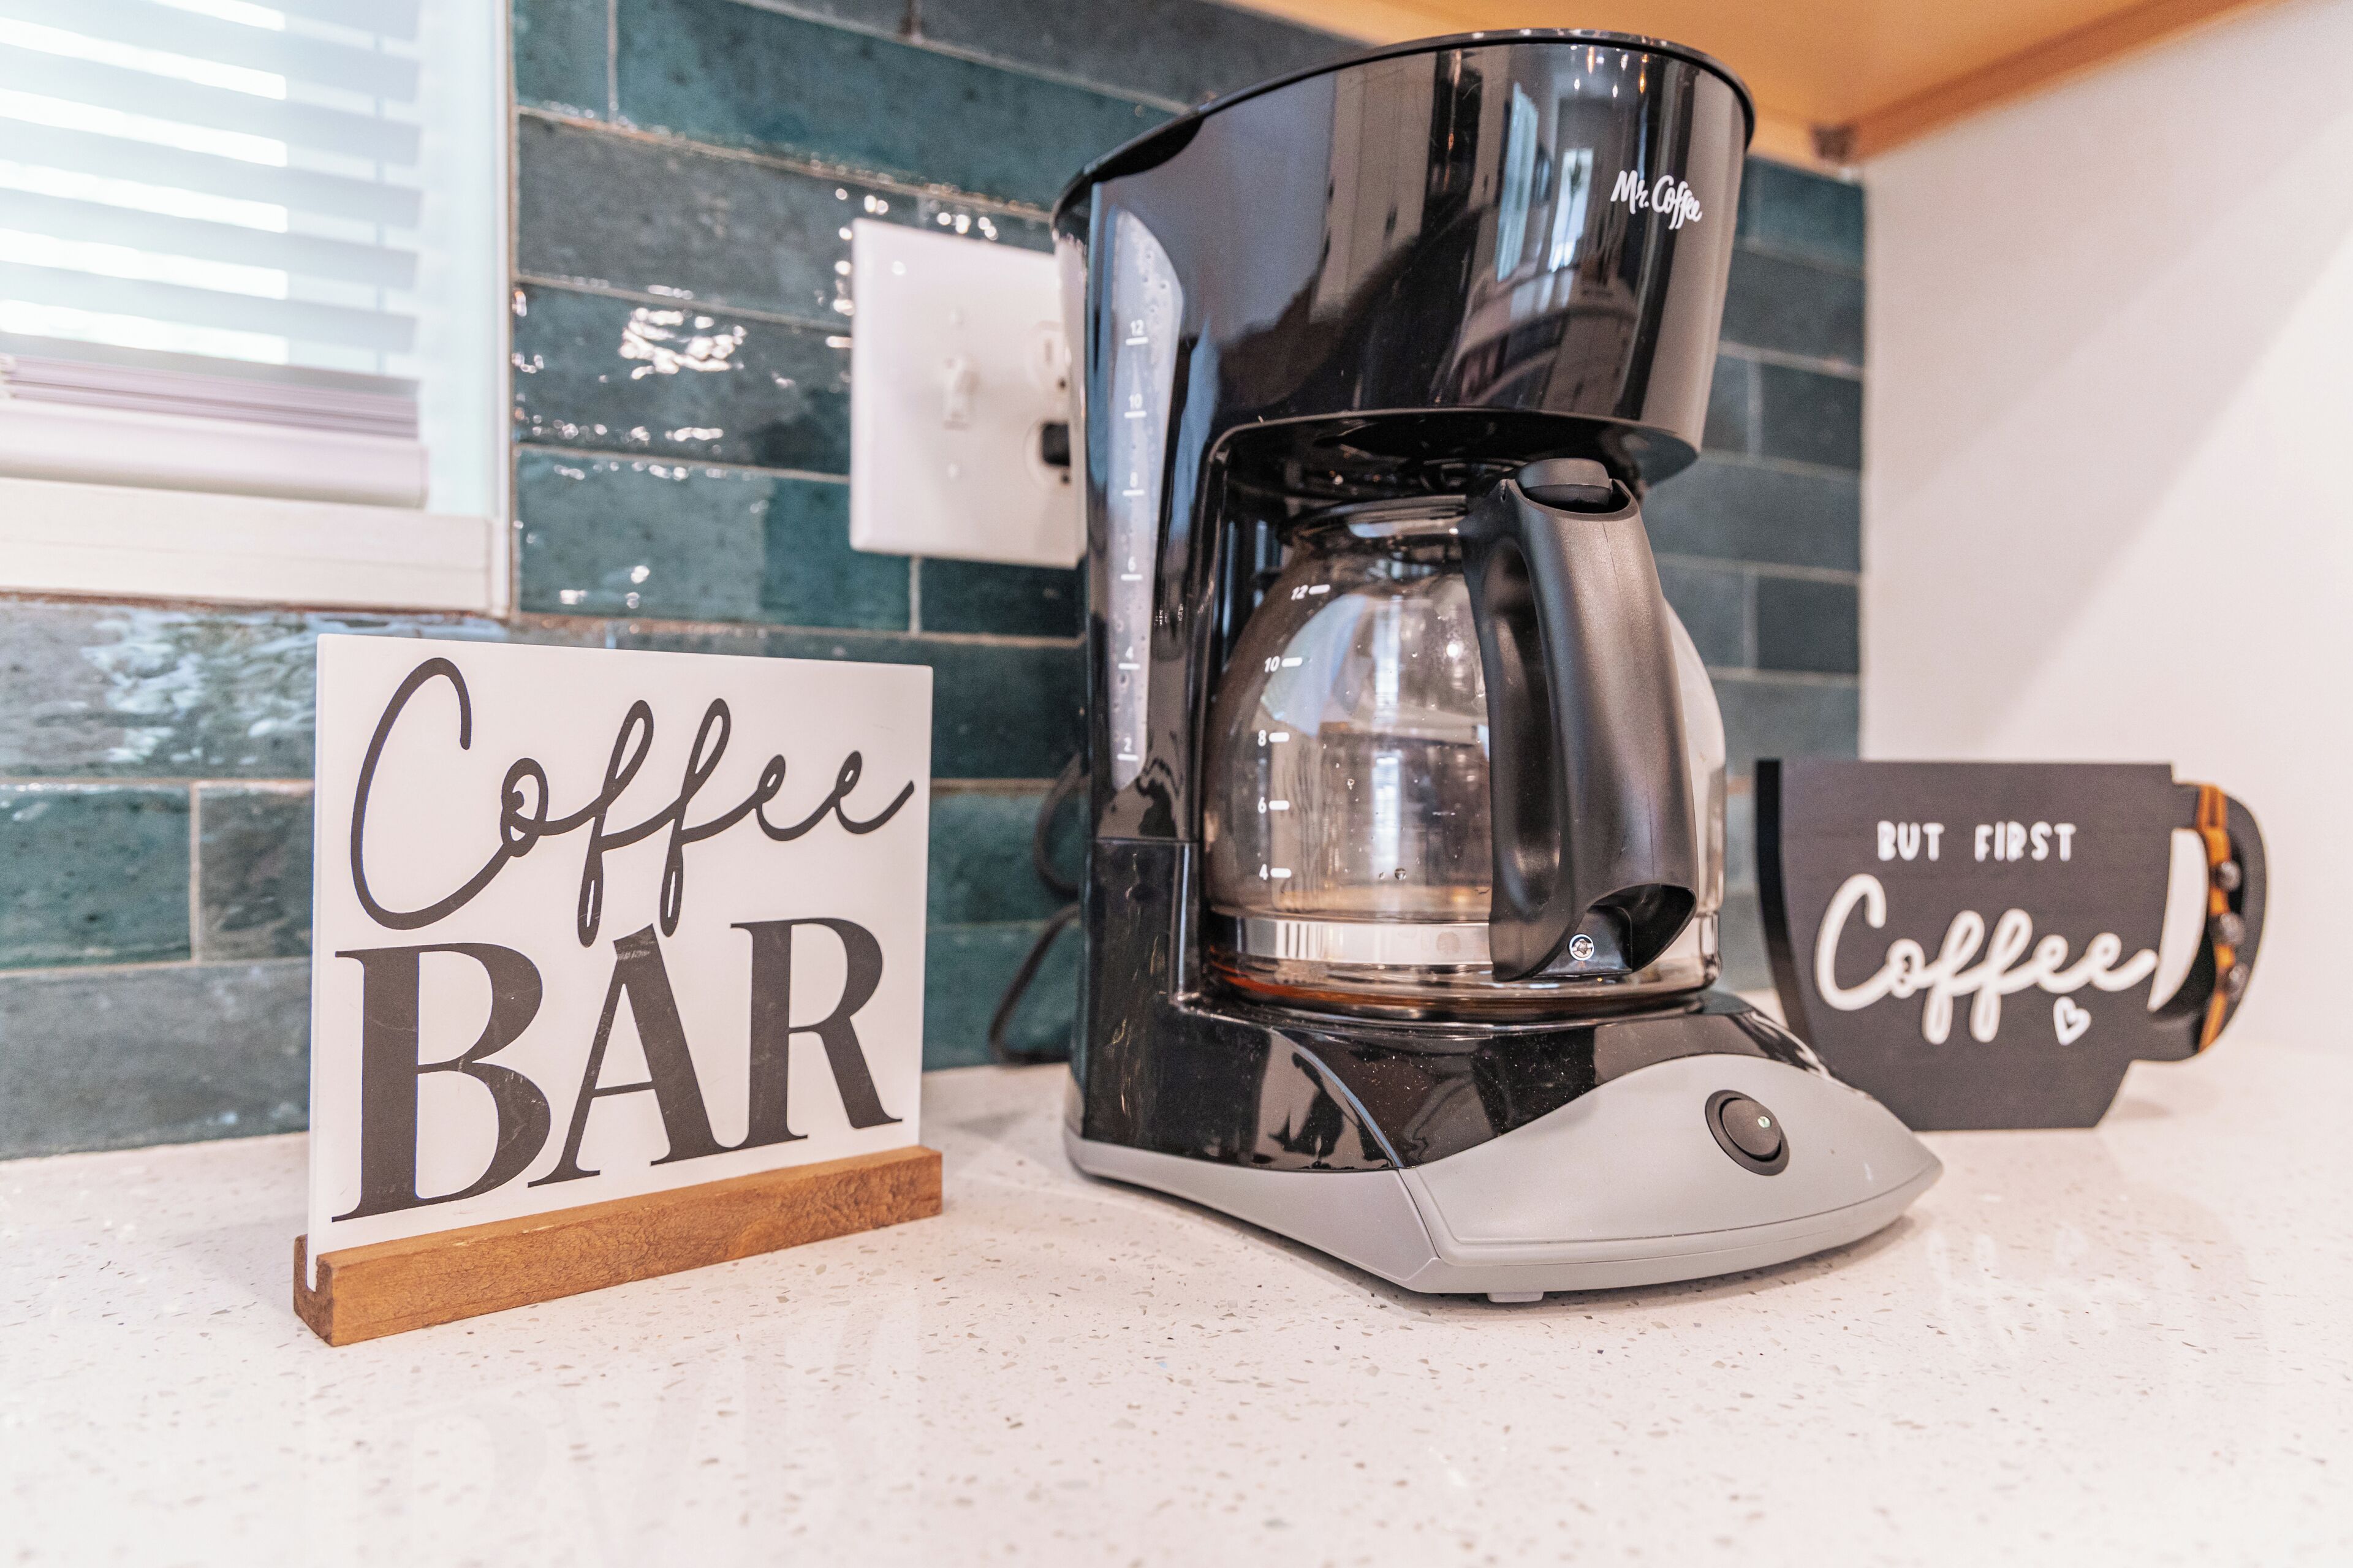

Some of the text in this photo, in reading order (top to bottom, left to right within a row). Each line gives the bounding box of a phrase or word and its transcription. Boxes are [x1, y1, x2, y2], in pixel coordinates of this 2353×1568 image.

[1610, 170, 1703, 230] Mr. Coffee
[1130, 319, 1145, 335] 12
[1129, 393, 1143, 409] 10
[1130, 472, 1139, 488] 8
[1128, 556, 1136, 572] 6
[1290, 584, 1309, 601] 12
[1125, 646, 1134, 661] 4
[1264, 656, 1280, 673] 10
[1124, 737, 1132, 752] 2
[1258, 729, 1267, 746] 8
[349, 656, 915, 949] Coffee
[1258, 796, 1267, 814] 6
[1876, 820, 2077, 862] BUT FIRST
[1259, 863, 1269, 881] 4
[1814, 873, 2161, 1045] Coffee
[330, 916, 903, 1224] BAR
